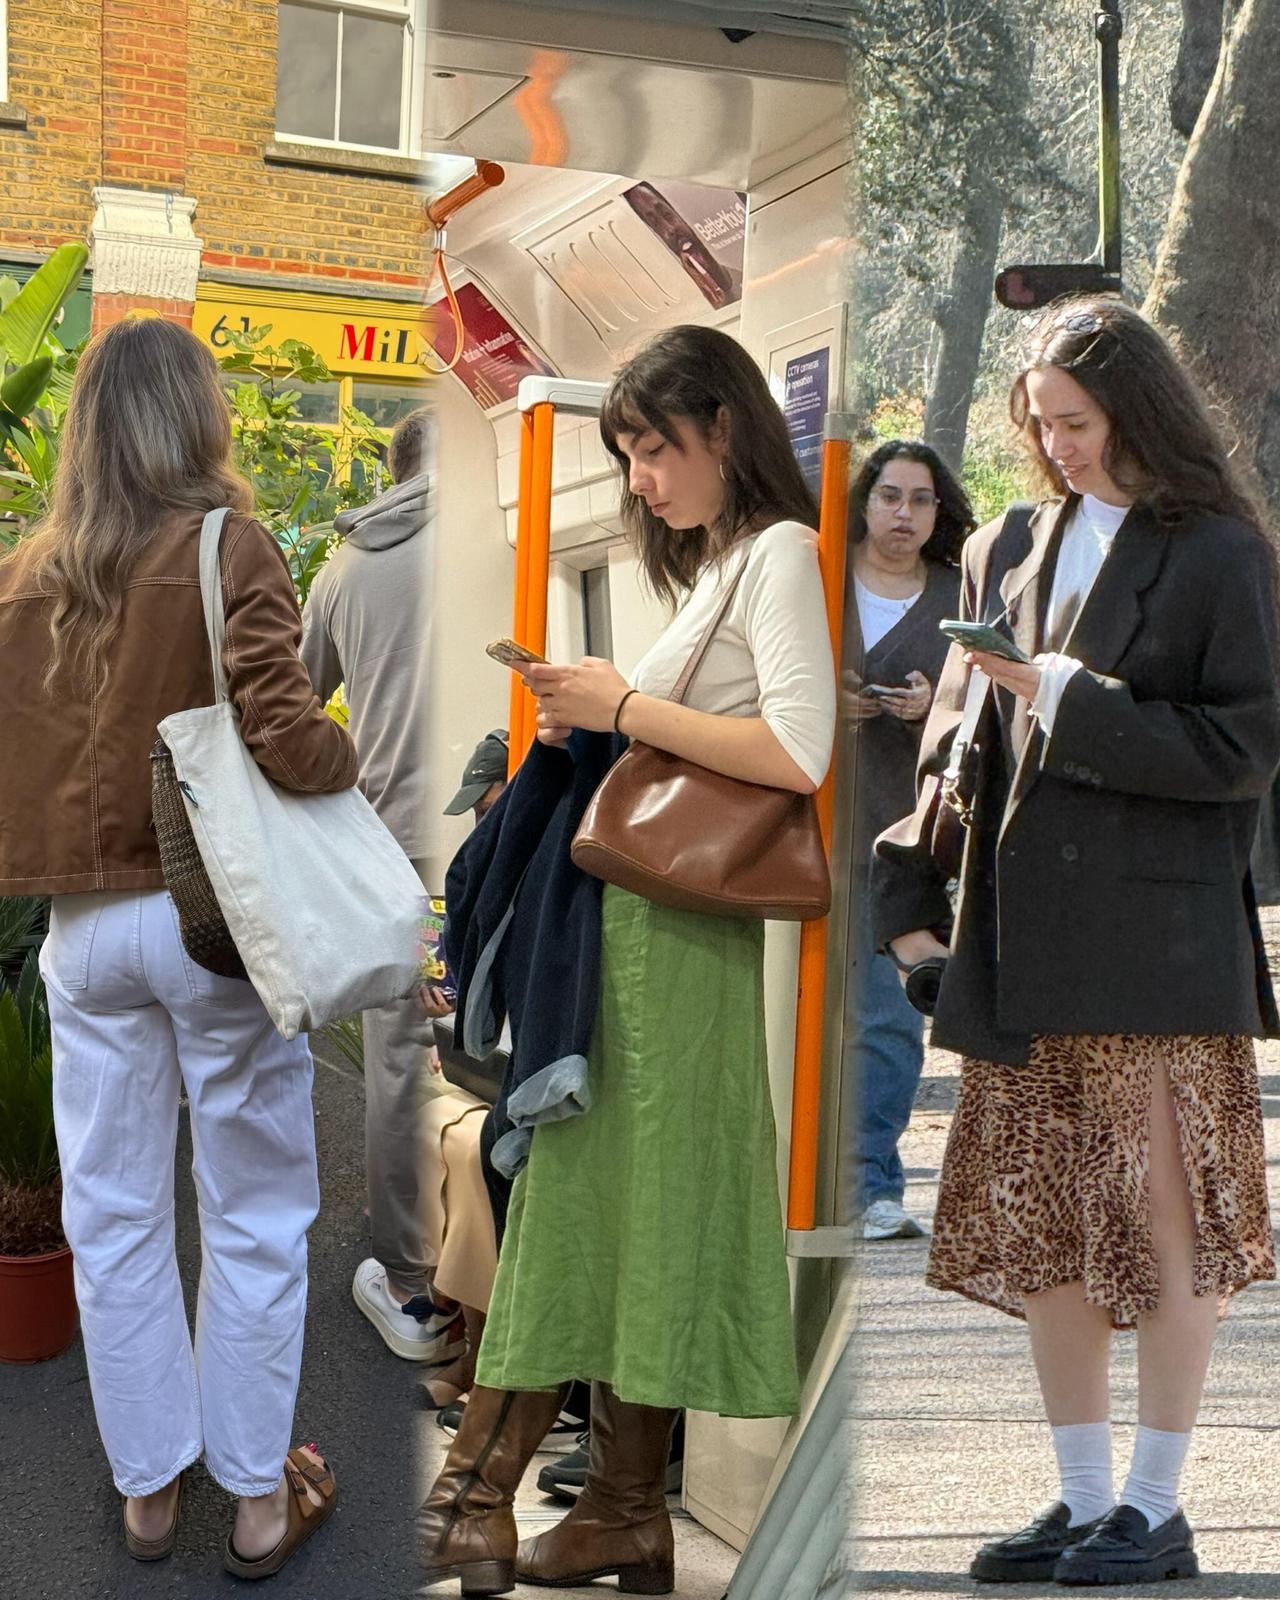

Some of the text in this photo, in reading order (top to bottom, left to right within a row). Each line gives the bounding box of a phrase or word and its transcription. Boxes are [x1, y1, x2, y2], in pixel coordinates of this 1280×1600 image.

[210, 314, 250, 348] 61
[336, 323, 430, 366] MiL
[787, 364, 800, 377] CCTV
